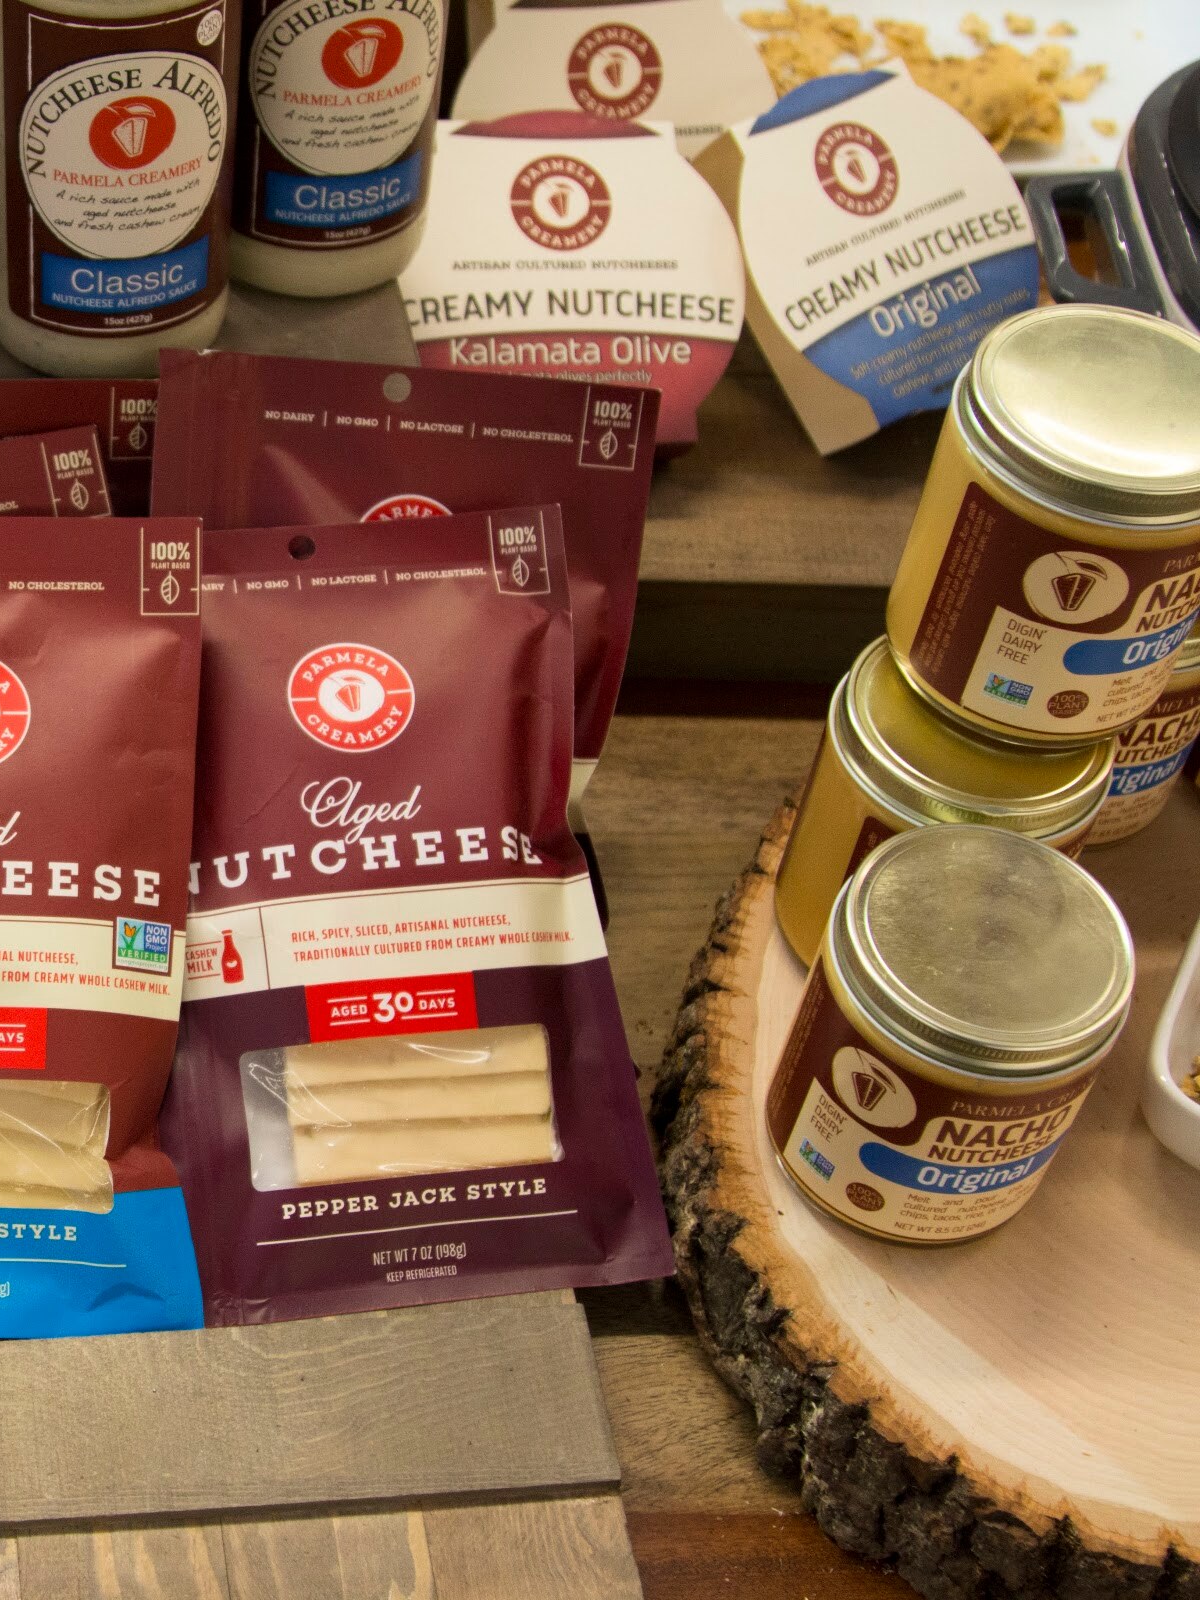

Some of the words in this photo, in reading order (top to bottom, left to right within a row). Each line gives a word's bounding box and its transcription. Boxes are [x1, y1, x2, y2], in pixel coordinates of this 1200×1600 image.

[26, 69, 142, 177] NUTCHEESE
[153, 61, 221, 161] ALFREDO
[53, 169, 123, 187] PARMELA
[128, 155, 203, 186] CREAMERY
[523, 160, 595, 188] PARMELA
[68, 191, 96, 204] rich
[100, 195, 138, 206] sauce
[295, 178, 400, 209] Classic
[83, 208, 111, 219] aged
[114, 202, 177, 218] nutcheese
[78, 219, 114, 231] fresh
[119, 219, 165, 231] cashew
[521, 215, 603, 248] CREAMERY
[71, 264, 183, 294] Classic
[785, 260, 881, 332] CREAMY
[885, 204, 1026, 277] NUTCHEESE
[52, 293, 113, 308] NUTCHEESE
[118, 293, 165, 308] ALFREDO
[168, 279, 198, 299] SAUCE
[548, 290, 735, 325] NUTCHEESE
[869, 263, 981, 338] Original
[450, 337, 600, 365] Kalamata
[611, 336, 692, 364] Olive
[595, 402, 633, 420] 100%
[265, 411, 278, 419] NO
[281, 412, 315, 422] DAIRY
[337, 416, 350, 425] NO
[354, 417, 379, 427] GMO
[400, 421, 413, 430] NO
[416, 422, 464, 434] LACTOSE
[483, 426, 497, 436] NO
[499, 428, 574, 443] CHOLESTEROL
[54, 449, 92, 470] 100%
[499, 527, 537, 546] 100%
[151, 542, 190, 560] 100%
[9, 580, 23, 590] NO
[26, 581, 105, 591] CHOLESTEROL
[997, 645, 1030, 664] FREE
[1003, 632, 1042, 653] DAIRY
[303, 652, 389, 682] PARMELA
[307, 706, 403, 744] CREAMERY
[301, 777, 421, 844] Aged
[146, 926, 167, 935] NON
[146, 935, 167, 945] GMO
[291, 930, 319, 943] RICH,
[322, 927, 352, 941] SPICY,
[356, 924, 391, 939] SLICED,
[395, 921, 449, 934] ARTISANAL
[453, 915, 511, 930] NUTCHEESE,
[18, 951, 79, 965] NUTCHEESE,
[120, 949, 166, 962] VERIFIED
[146, 944, 166, 952] Project
[186, 948, 217, 960] CASHEW
[294, 949, 371, 962] TRADITIONALLY
[374, 943, 422, 956] CULTURED
[426, 939, 453, 951] FROM
[456, 936, 496, 949] CREAMY
[499, 933, 529, 944] WHOLE
[532, 933, 555, 943] CASHEW
[557, 932, 574, 942] MILK.
[187, 960, 213, 973] MILK
[2, 970, 30, 982] FROM
[34, 971, 75, 984] CREAMY
[79, 974, 110, 987] WHOLE
[114, 977, 146, 992] CASHEW
[148, 982, 170, 996] MILK.
[331, 1004, 367, 1017] AGED
[373, 992, 414, 1023] 30
[419, 997, 455, 1011] DAYS
[815, 1105, 843, 1135] DAIRY
[952, 1101, 1041, 1117] PARMELA
[811, 1116, 834, 1143] FREE
[935, 1105, 1072, 1147] NACHO
[928, 1132, 1057, 1164] NUTCHEESE
[917, 1157, 1035, 1193] Original
[283, 1194, 379, 1220] PEPPER
[390, 1187, 456, 1209] JACK
[467, 1179, 548, 1200] STYLE
[894, 1221, 914, 1231] NET
